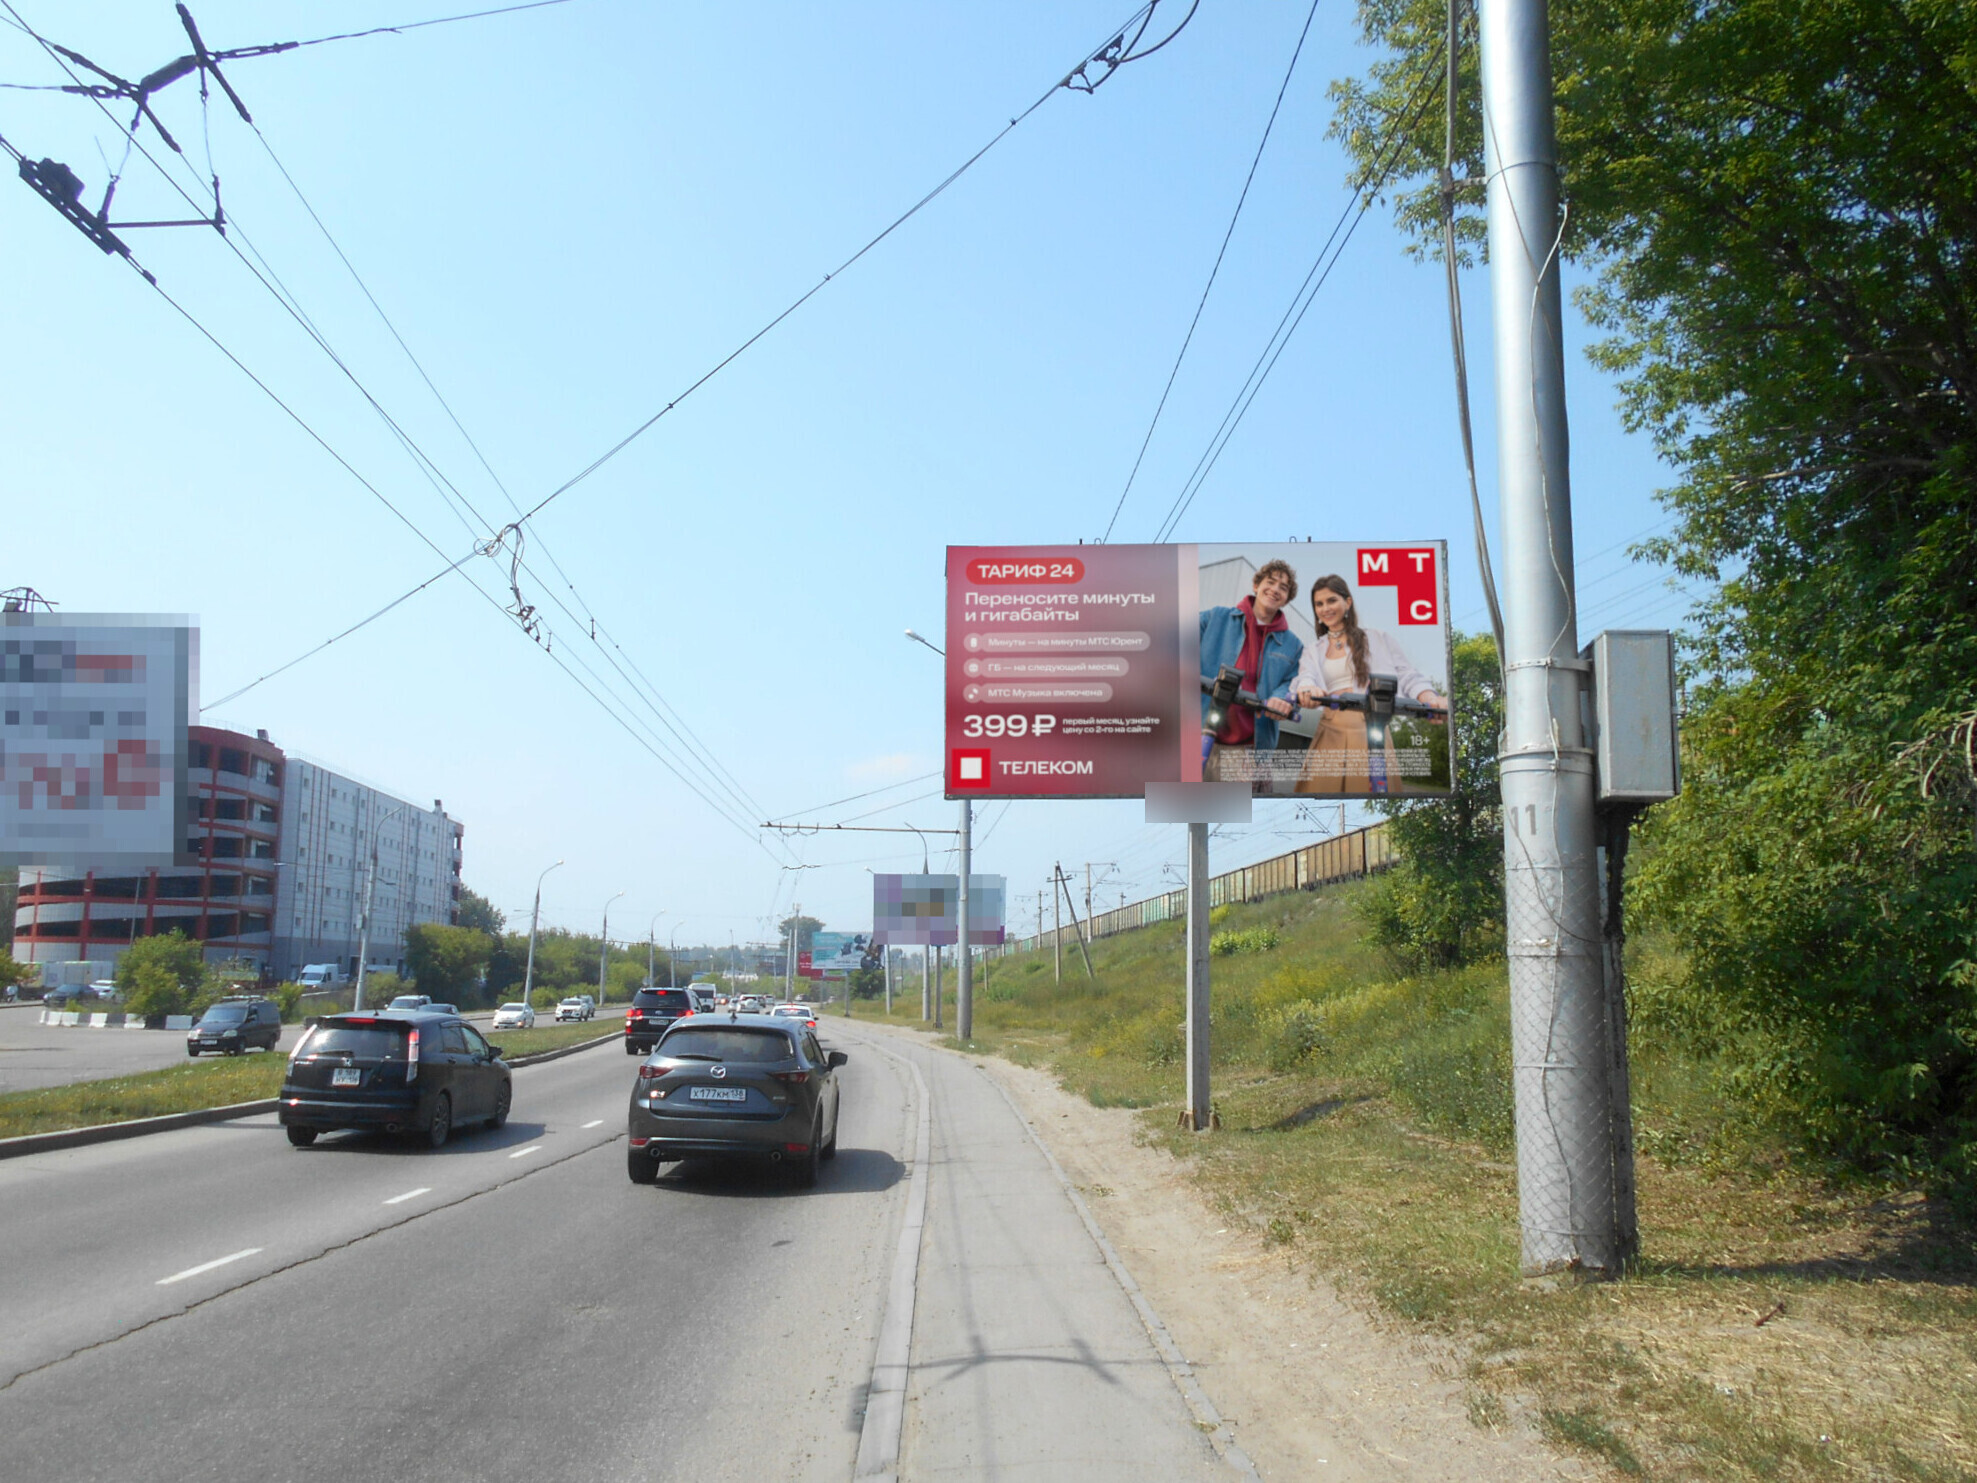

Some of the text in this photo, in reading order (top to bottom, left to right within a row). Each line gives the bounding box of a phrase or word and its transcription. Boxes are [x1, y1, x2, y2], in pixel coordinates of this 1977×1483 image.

[977, 563, 1075, 578] ТАРИФ 24
[965, 592, 1155, 608] Переносите минуты
[965, 607, 1080, 622] и гигабайты
[988, 638, 1026, 648] Минуты
[1050, 638, 1087, 647] минуты
[1088, 637, 1110, 646] МТС
[1110, 637, 1143, 648] Юрент
[988, 663, 1001, 672] ГБ
[1027, 662, 1086, 673] следующий
[1088, 663, 1119, 673] месяц
[988, 688, 1104, 698] МТС Музыка включена
[1062, 716, 1095, 726] первый
[1125, 716, 1160, 727] узнайте
[1062, 725, 1152, 735] цену со 2-го на сайте
[1410, 735, 1431, 746] 18+
[999, 760, 1093, 775] ТЕЛЕКОМ
[1510, 803, 1537, 836] 11
